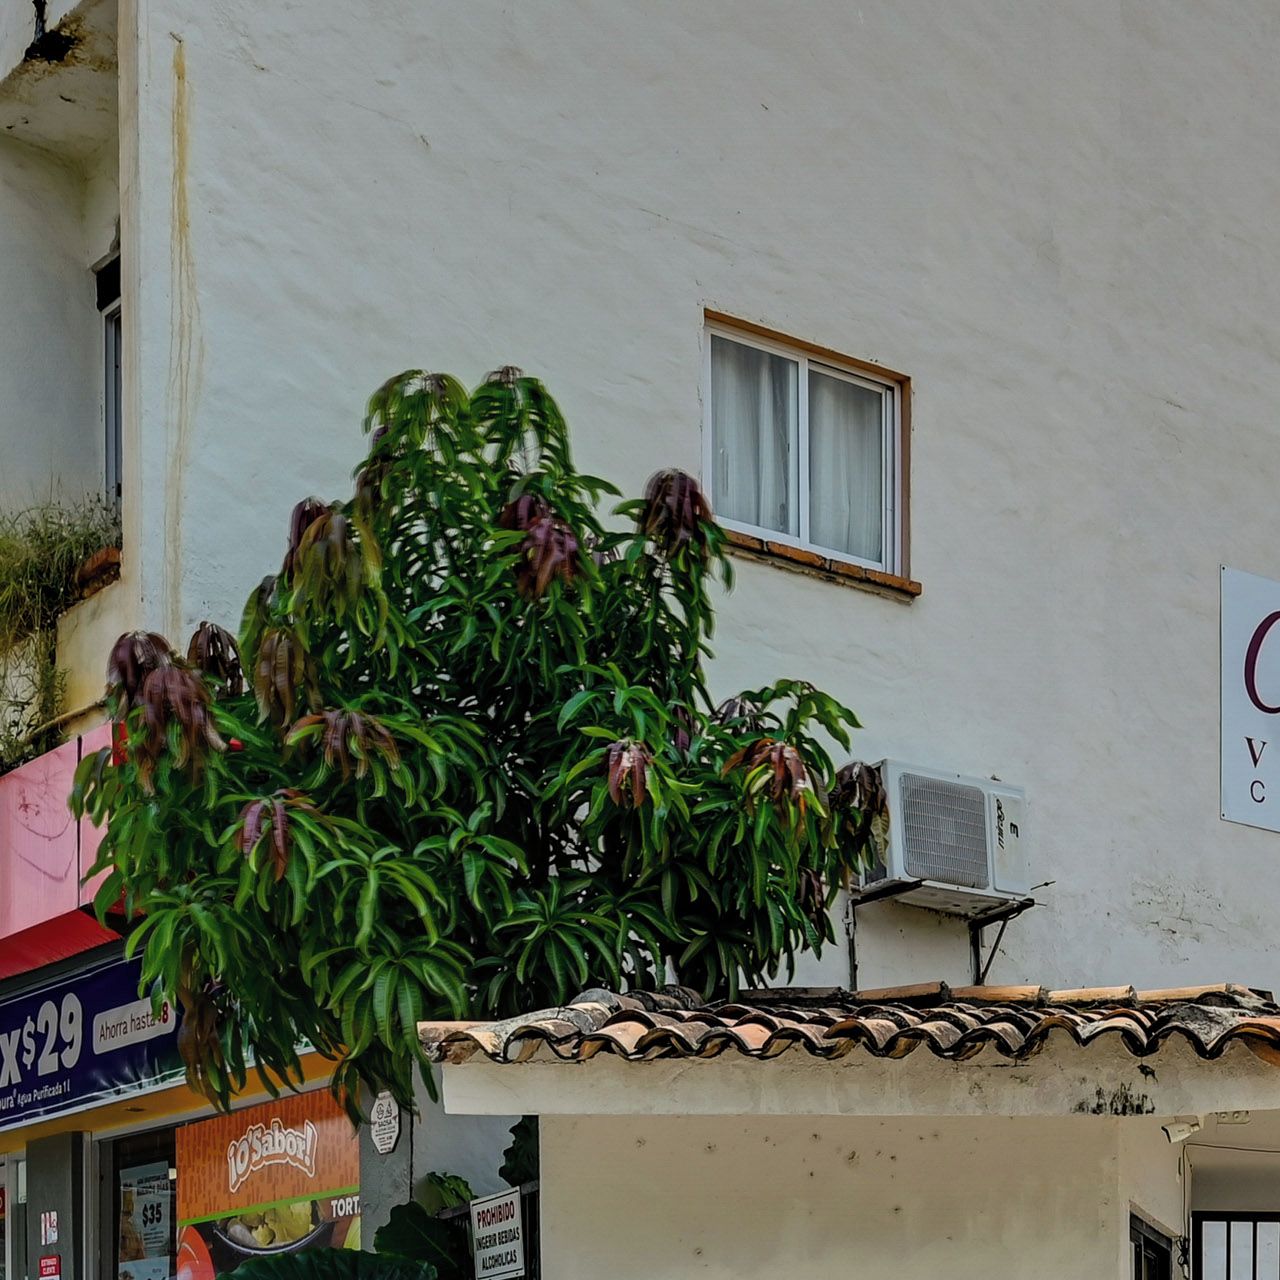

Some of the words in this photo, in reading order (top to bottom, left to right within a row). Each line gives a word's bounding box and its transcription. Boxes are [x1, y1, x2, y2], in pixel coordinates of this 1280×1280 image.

[100, 1020, 128, 1043] Ahorra
[33, 1082, 63, 1102] Purificada
[143, 1202, 162, 1228] $35
[330, 1195, 361, 1218] TORT
[477, 1200, 515, 1229] PROHIBIDO
[475, 1232, 497, 1251] INGERIR
[498, 1226, 520, 1246] BEBIDAS
